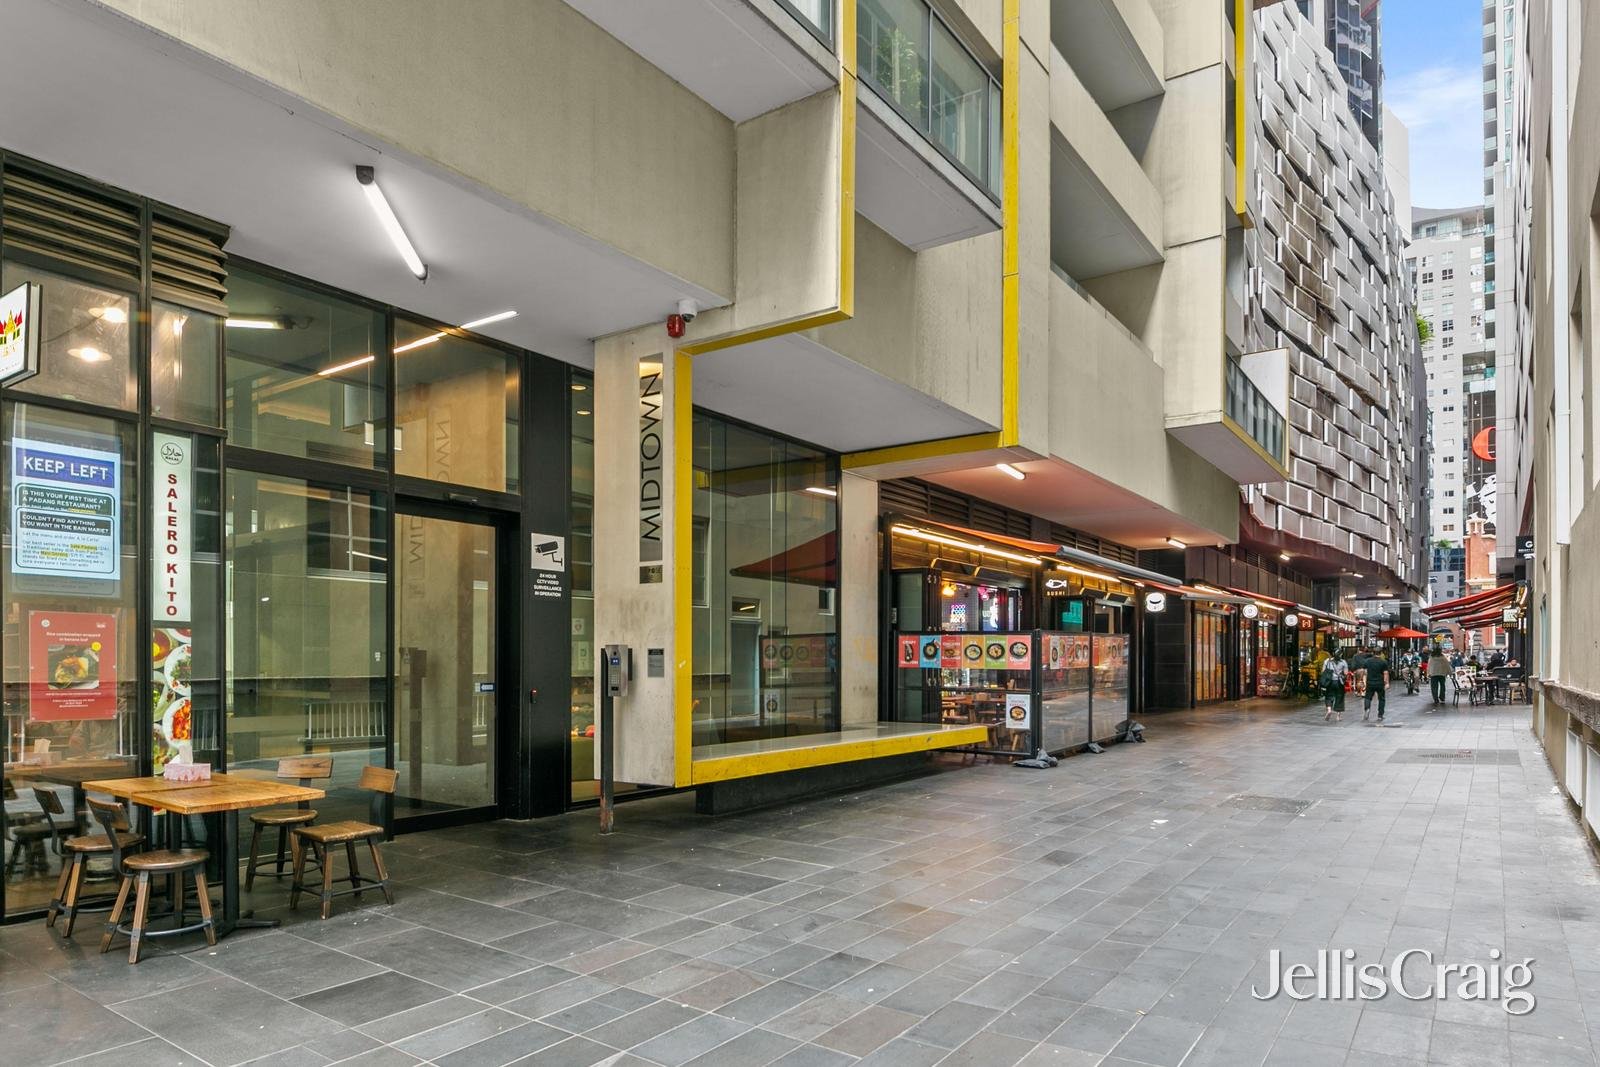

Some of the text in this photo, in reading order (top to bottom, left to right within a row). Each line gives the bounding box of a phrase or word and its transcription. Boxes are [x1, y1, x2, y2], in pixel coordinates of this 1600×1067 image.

[23, 456, 108, 480] KEEP LEFT
[641, 372, 660, 541] MIDTOWN
[28, 496, 55, 505] PADANG
[66, 518, 96, 526] ANYTHING
[166, 474, 178, 616] SALERO KITO
